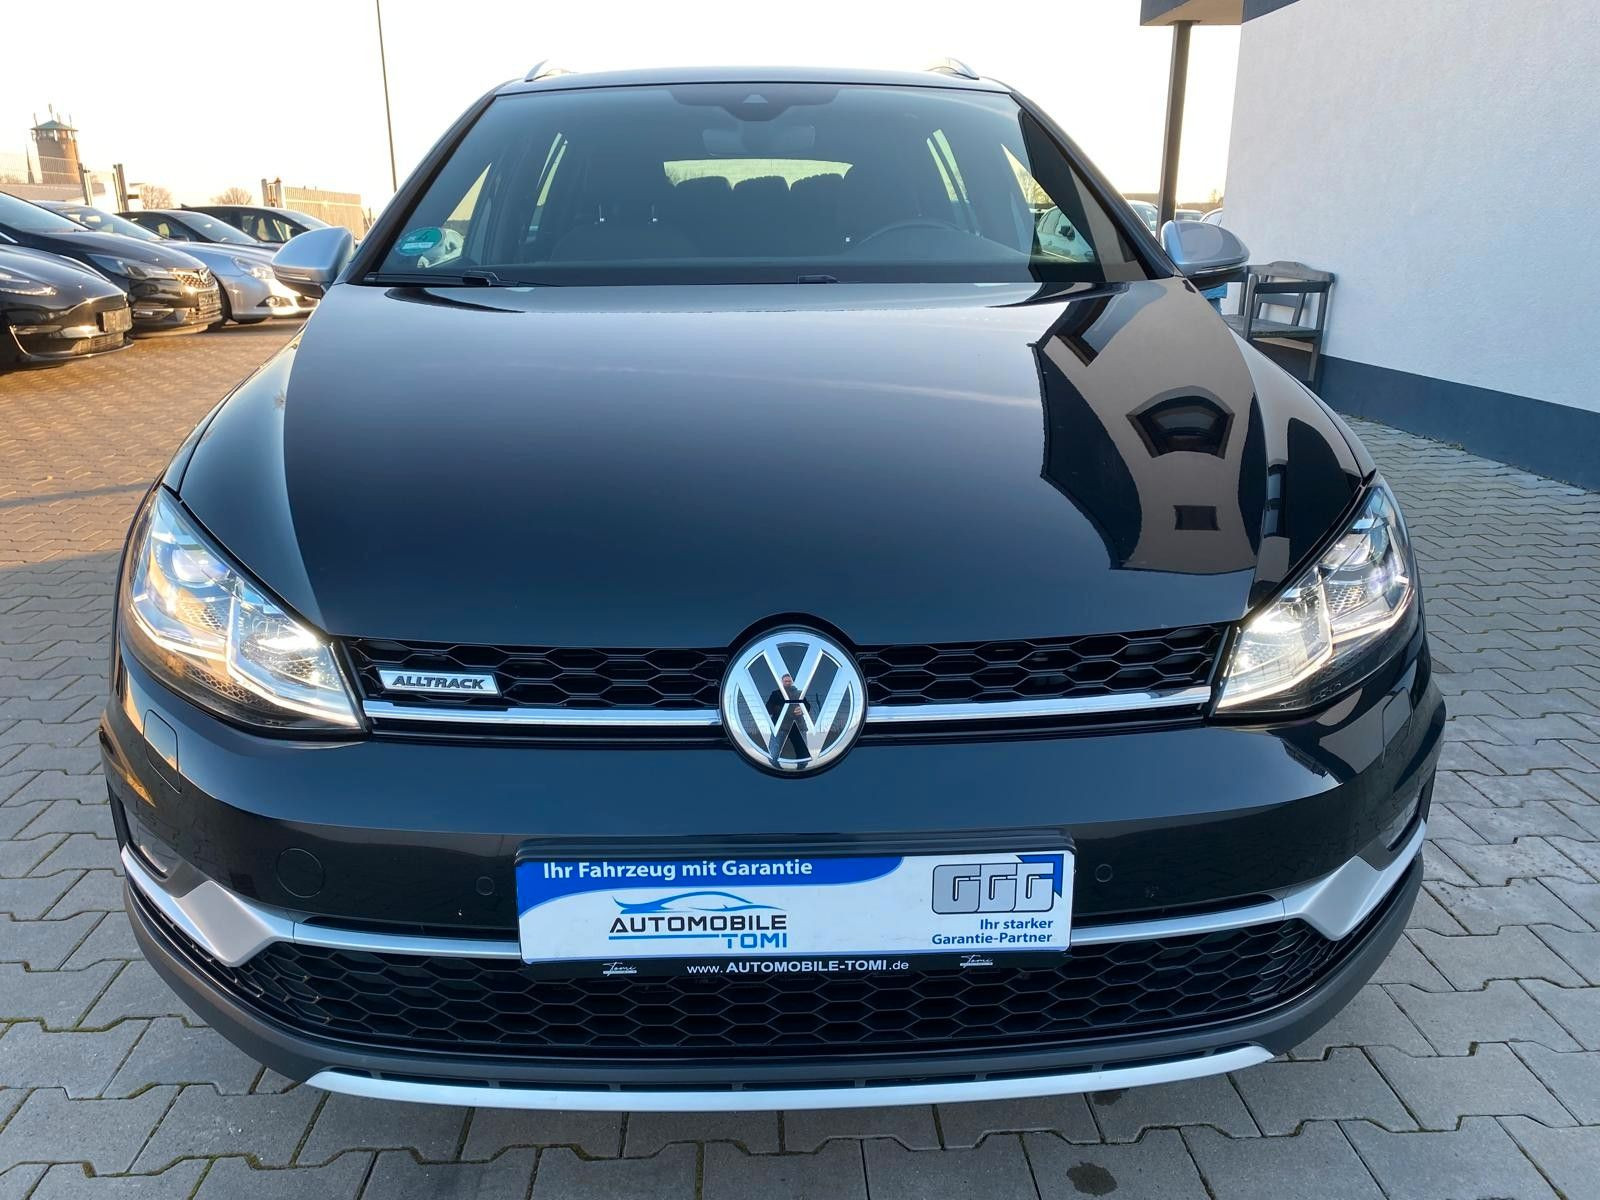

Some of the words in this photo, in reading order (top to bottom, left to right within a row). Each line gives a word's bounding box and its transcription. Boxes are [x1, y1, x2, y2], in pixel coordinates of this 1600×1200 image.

[392, 675, 484, 690] ALLTRACK
[543, 862, 572, 879] Ihr
[578, 861, 676, 881] Fahrzeug
[682, 861, 717, 877] mit
[721, 859, 813, 876] Garantie
[609, 915, 788, 933] AUTOMOBILE
[980, 919, 1000, 930] Ihr
[1003, 918, 1053, 929] starker
[721, 933, 788, 949] TOMI
[931, 932, 1053, 945] Garantie-Partner
